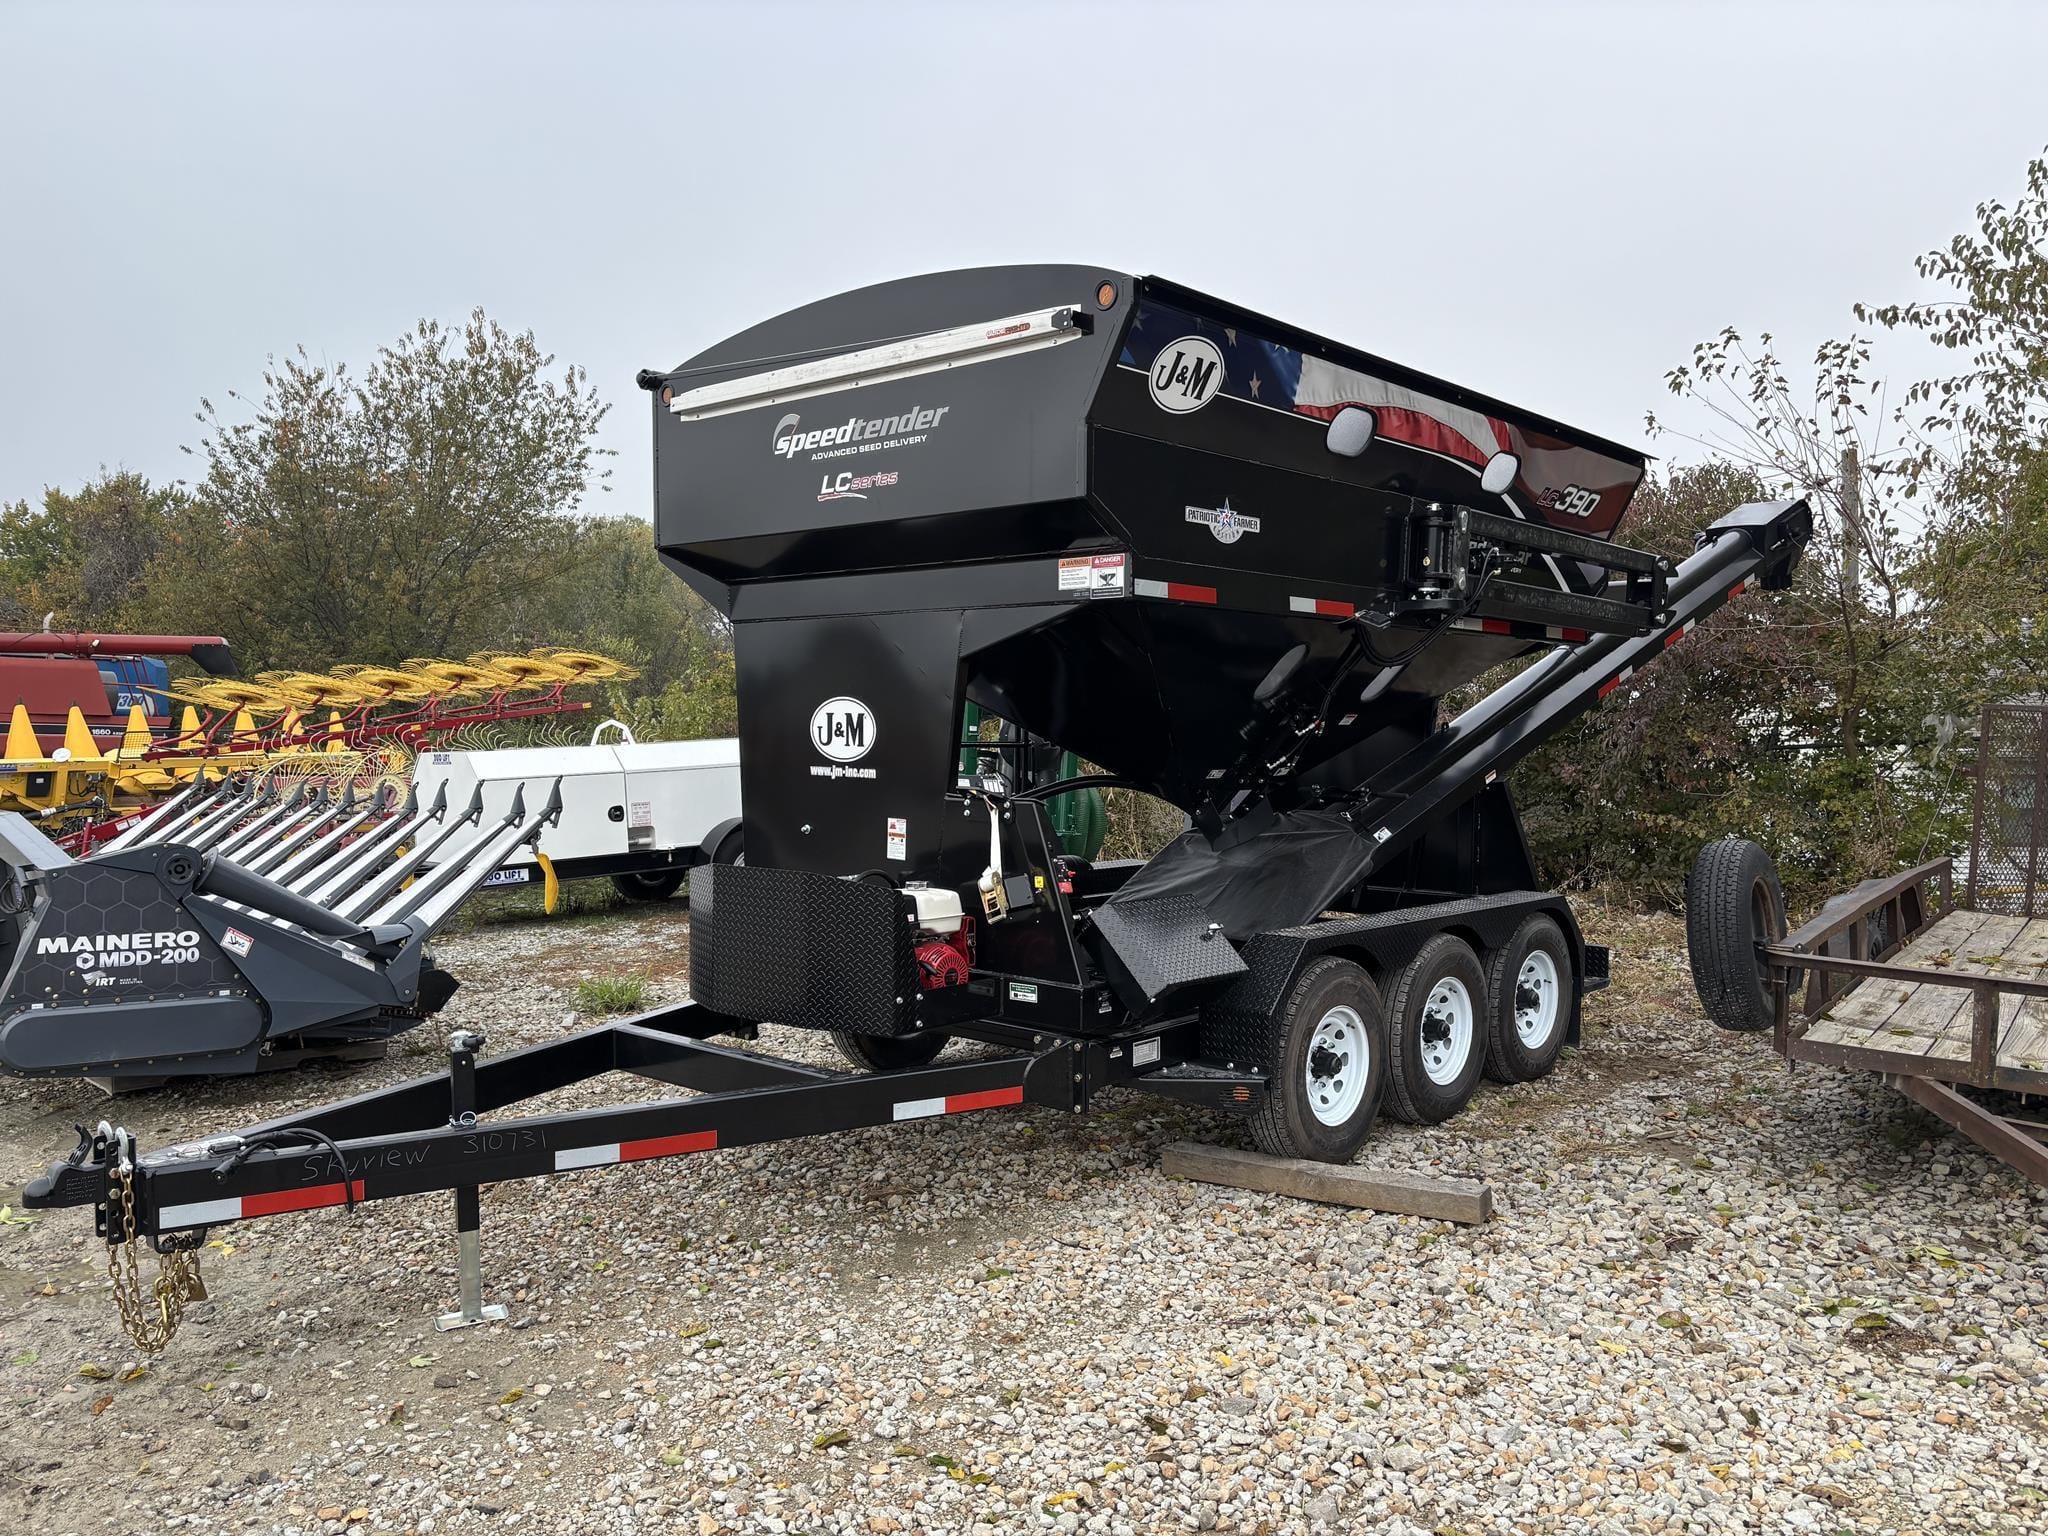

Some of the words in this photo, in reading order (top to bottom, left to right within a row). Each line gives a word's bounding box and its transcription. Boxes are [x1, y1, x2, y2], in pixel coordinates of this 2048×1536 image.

[1156, 351, 1217, 401] J&M
[811, 447, 858, 461] ADVANCED
[859, 443, 882, 453] SEED
[883, 434, 928, 449] DELIVERY
[1187, 508, 1221, 524] PATRIOTIC
[1233, 517, 1259, 530] FARMER
[1100, 555, 1121, 563] DANGER
[817, 713, 865, 747] J&M
[810, 765, 877, 779] www.jm-inc.com
[37, 931, 200, 954] MAINERO
[99, 948, 200, 967] MDD-200
[95, 977, 116, 987] IRT
[463, 1129, 547, 1154] 310731
